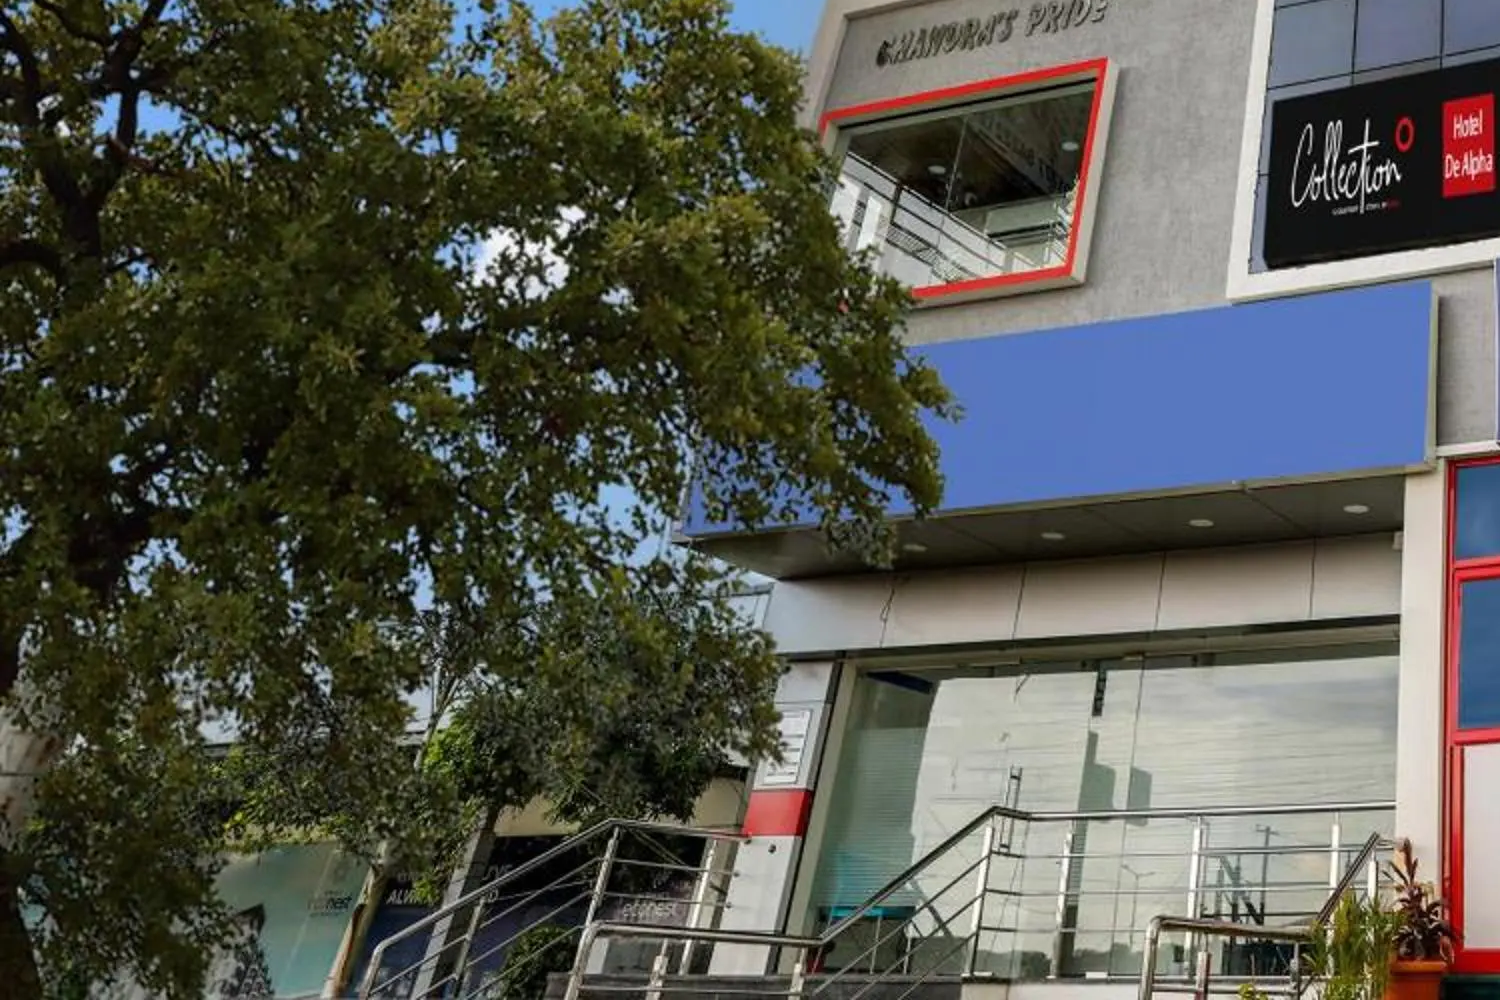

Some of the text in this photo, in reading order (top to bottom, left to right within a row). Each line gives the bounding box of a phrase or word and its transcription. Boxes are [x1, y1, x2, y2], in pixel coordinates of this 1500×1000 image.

[876, 9, 1019, 67] CHANDRA'S
[1453, 108, 1483, 140] Hotel
[1291, 119, 1402, 214] Collection
[1445, 152, 1494, 183] De Alpha
